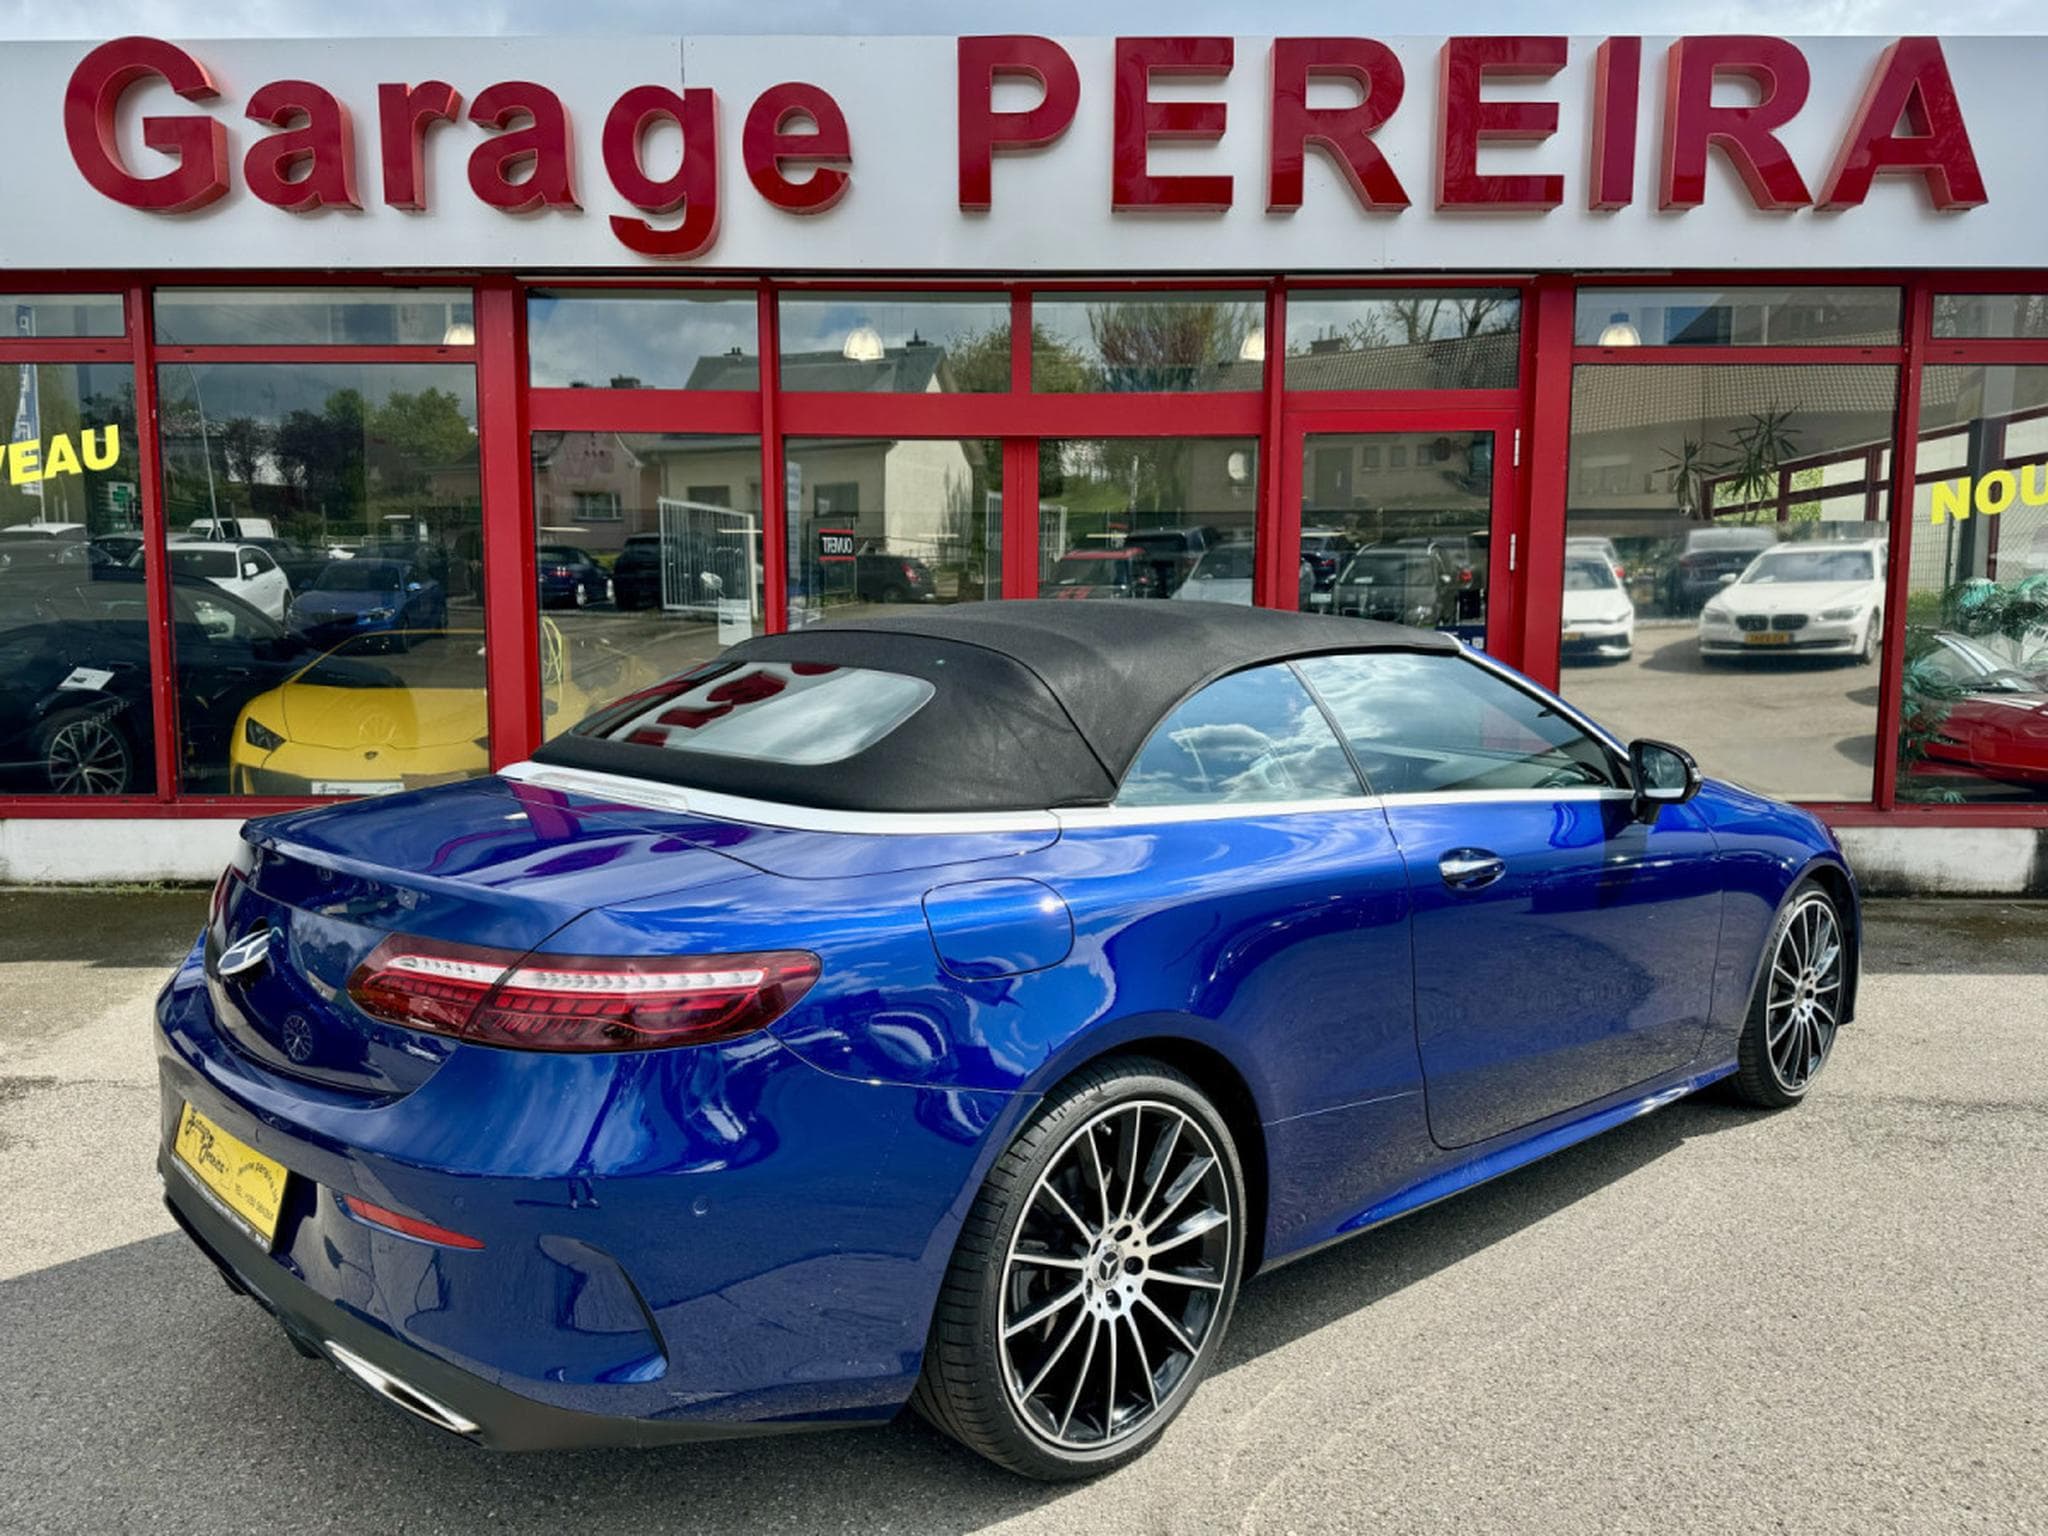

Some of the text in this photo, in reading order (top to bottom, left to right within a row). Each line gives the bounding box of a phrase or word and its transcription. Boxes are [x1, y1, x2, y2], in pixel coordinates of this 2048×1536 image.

[64, 35, 1989, 259] Garage PEREIRA
[0, 423, 121, 486] EAU
